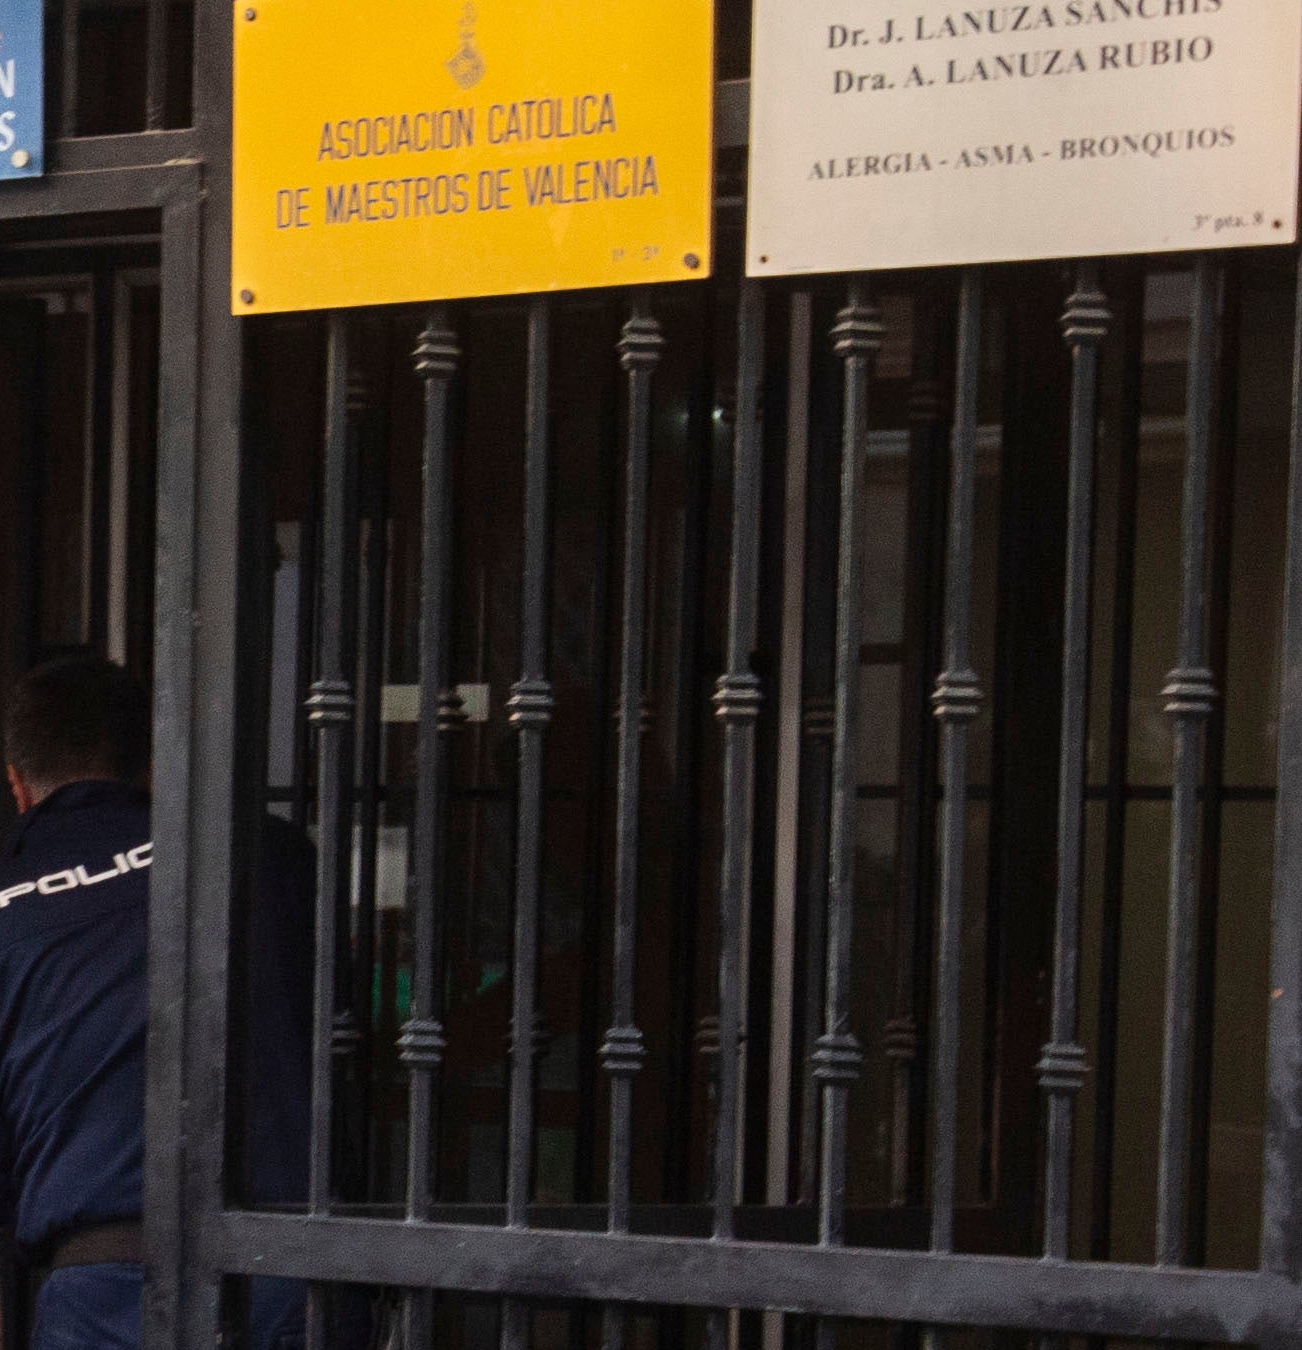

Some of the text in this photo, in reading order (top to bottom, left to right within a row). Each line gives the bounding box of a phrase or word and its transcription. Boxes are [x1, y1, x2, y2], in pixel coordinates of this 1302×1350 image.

[827, 24, 870, 49] Dr.
[878, 18, 903, 45] J.
[915, 4, 1055, 41] LANUZA
[834, 36, 1213, 95] Dra. A. LANUZA RUBIO
[808, 151, 933, 181] ALERGIA
[955, 143, 1034, 169] ASMA
[1059, 125, 1236, 161] BRONQUIOS
[276, 155, 659, 229] DE MAESTROS DE VALENCIA
